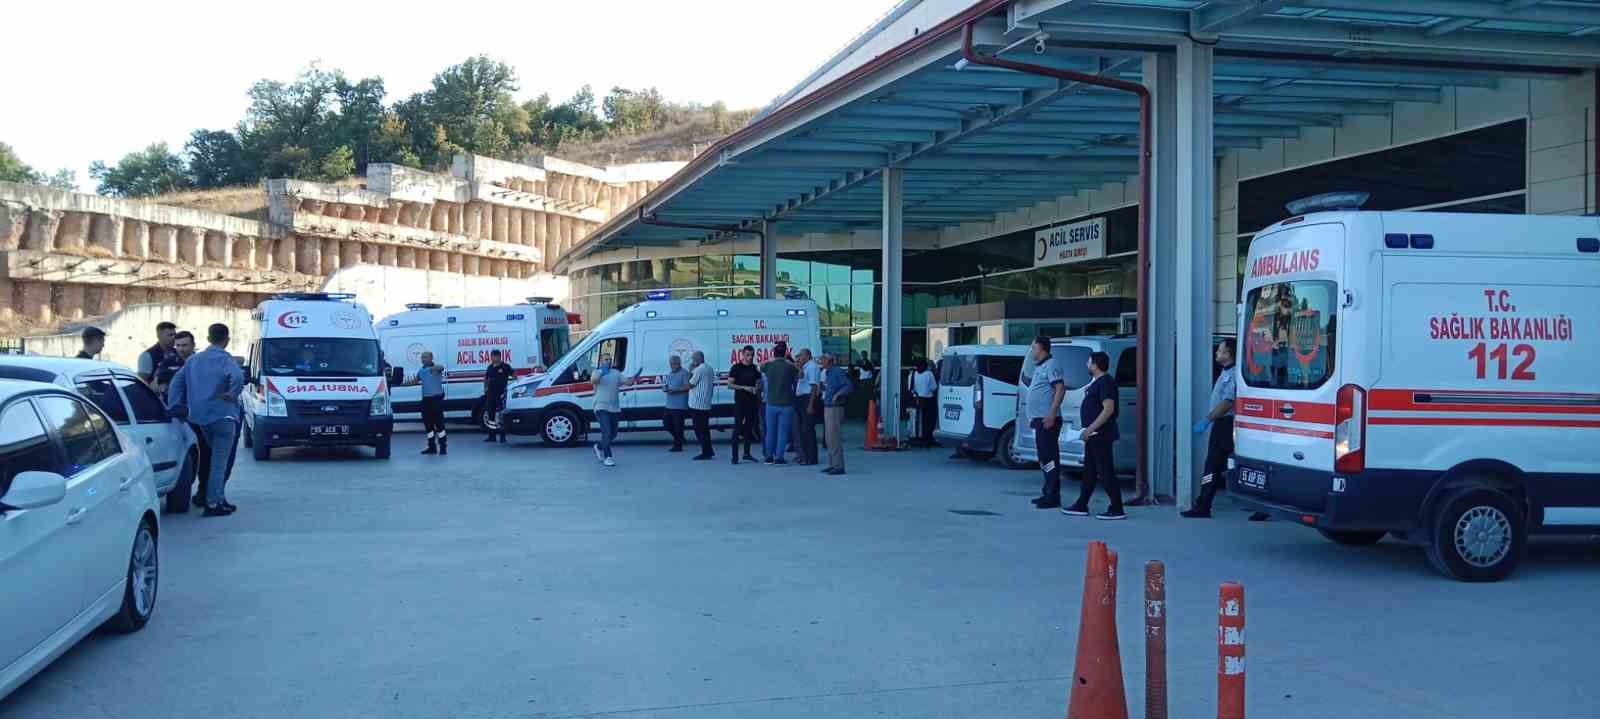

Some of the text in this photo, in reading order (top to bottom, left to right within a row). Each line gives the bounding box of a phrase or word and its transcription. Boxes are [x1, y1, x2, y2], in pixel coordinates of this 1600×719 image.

[1049, 229, 1068, 248] ACİL
[1251, 249, 1320, 279] AMBULANS
[1484, 289, 1516, 312] T.C.
[288, 315, 308, 324] 112
[1430, 313, 1573, 341] SAĞLIK BAKANLIĞI
[1468, 342, 1536, 380] 112
